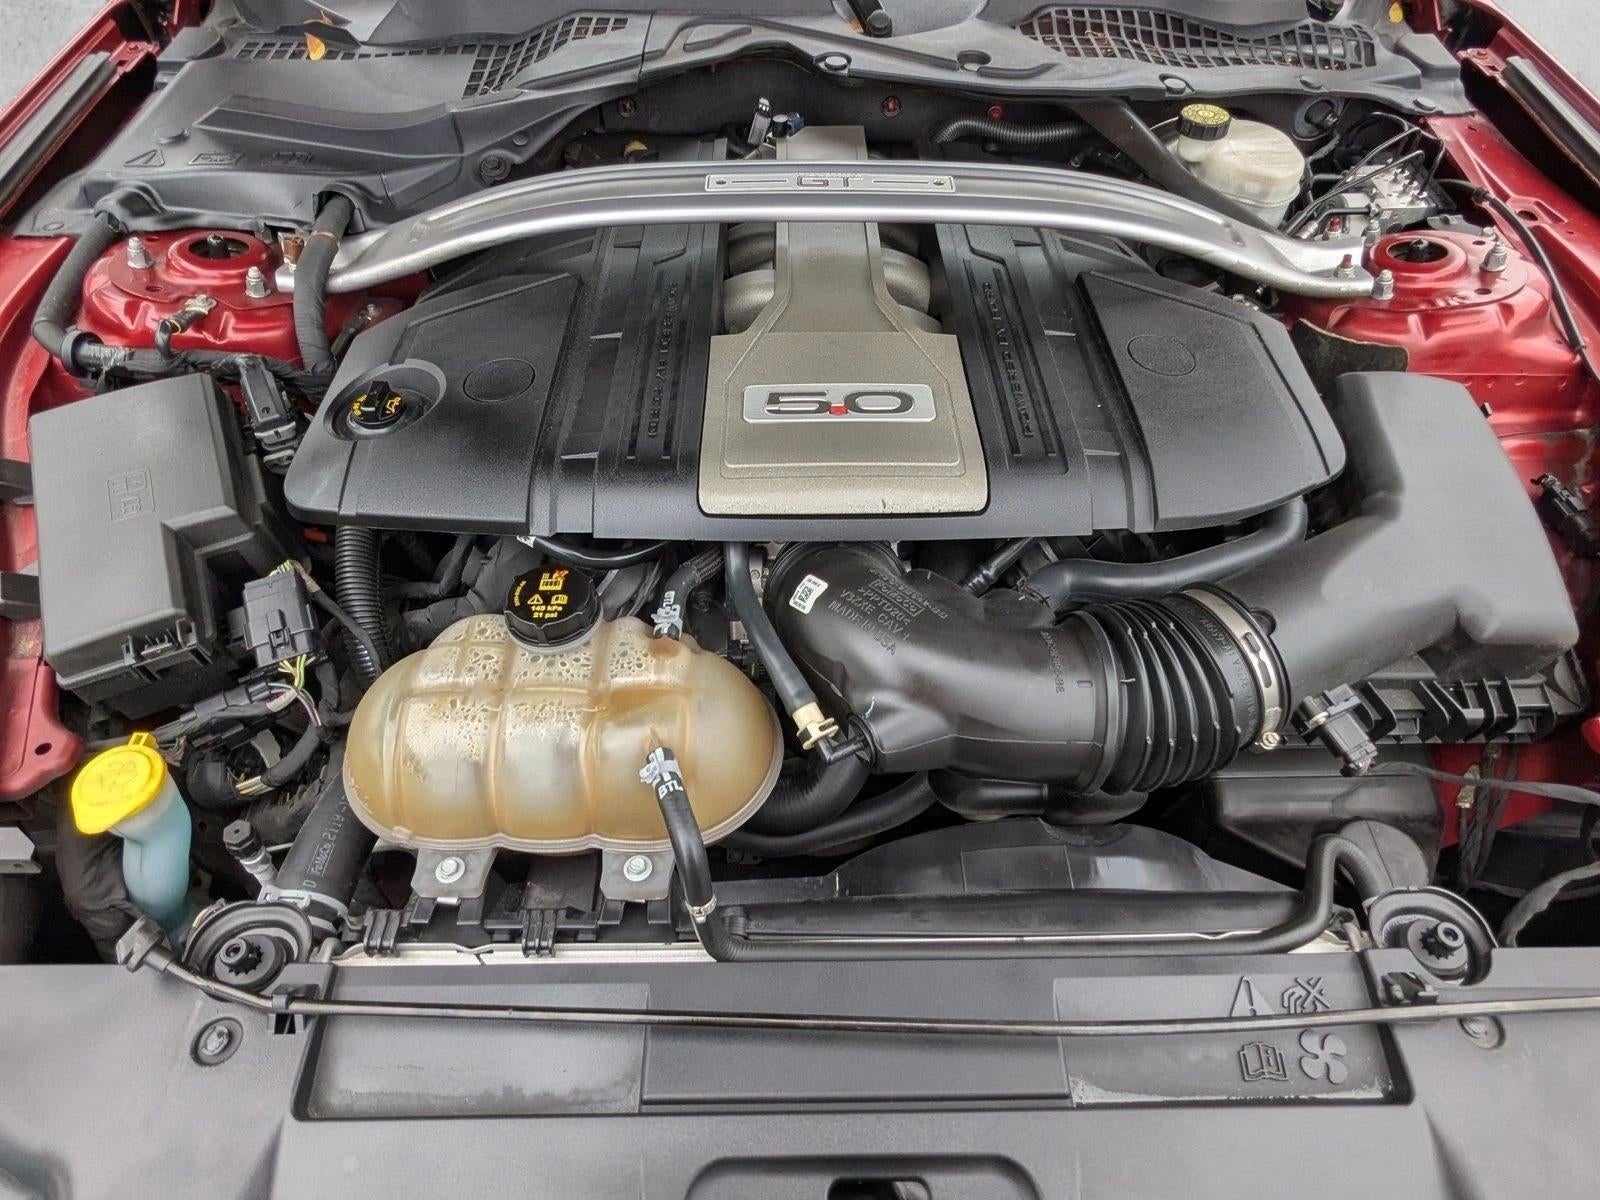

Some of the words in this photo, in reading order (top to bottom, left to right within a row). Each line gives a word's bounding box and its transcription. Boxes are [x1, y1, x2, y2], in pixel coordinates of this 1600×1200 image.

[797, 174, 863, 187] GT
[765, 391, 914, 415] 5.0
[828, 600, 863, 625] MADE
[860, 618, 874, 635] IN
[873, 632, 897, 656] USA
[877, 613, 904, 634] CAV
[658, 780, 684, 799] BTL
